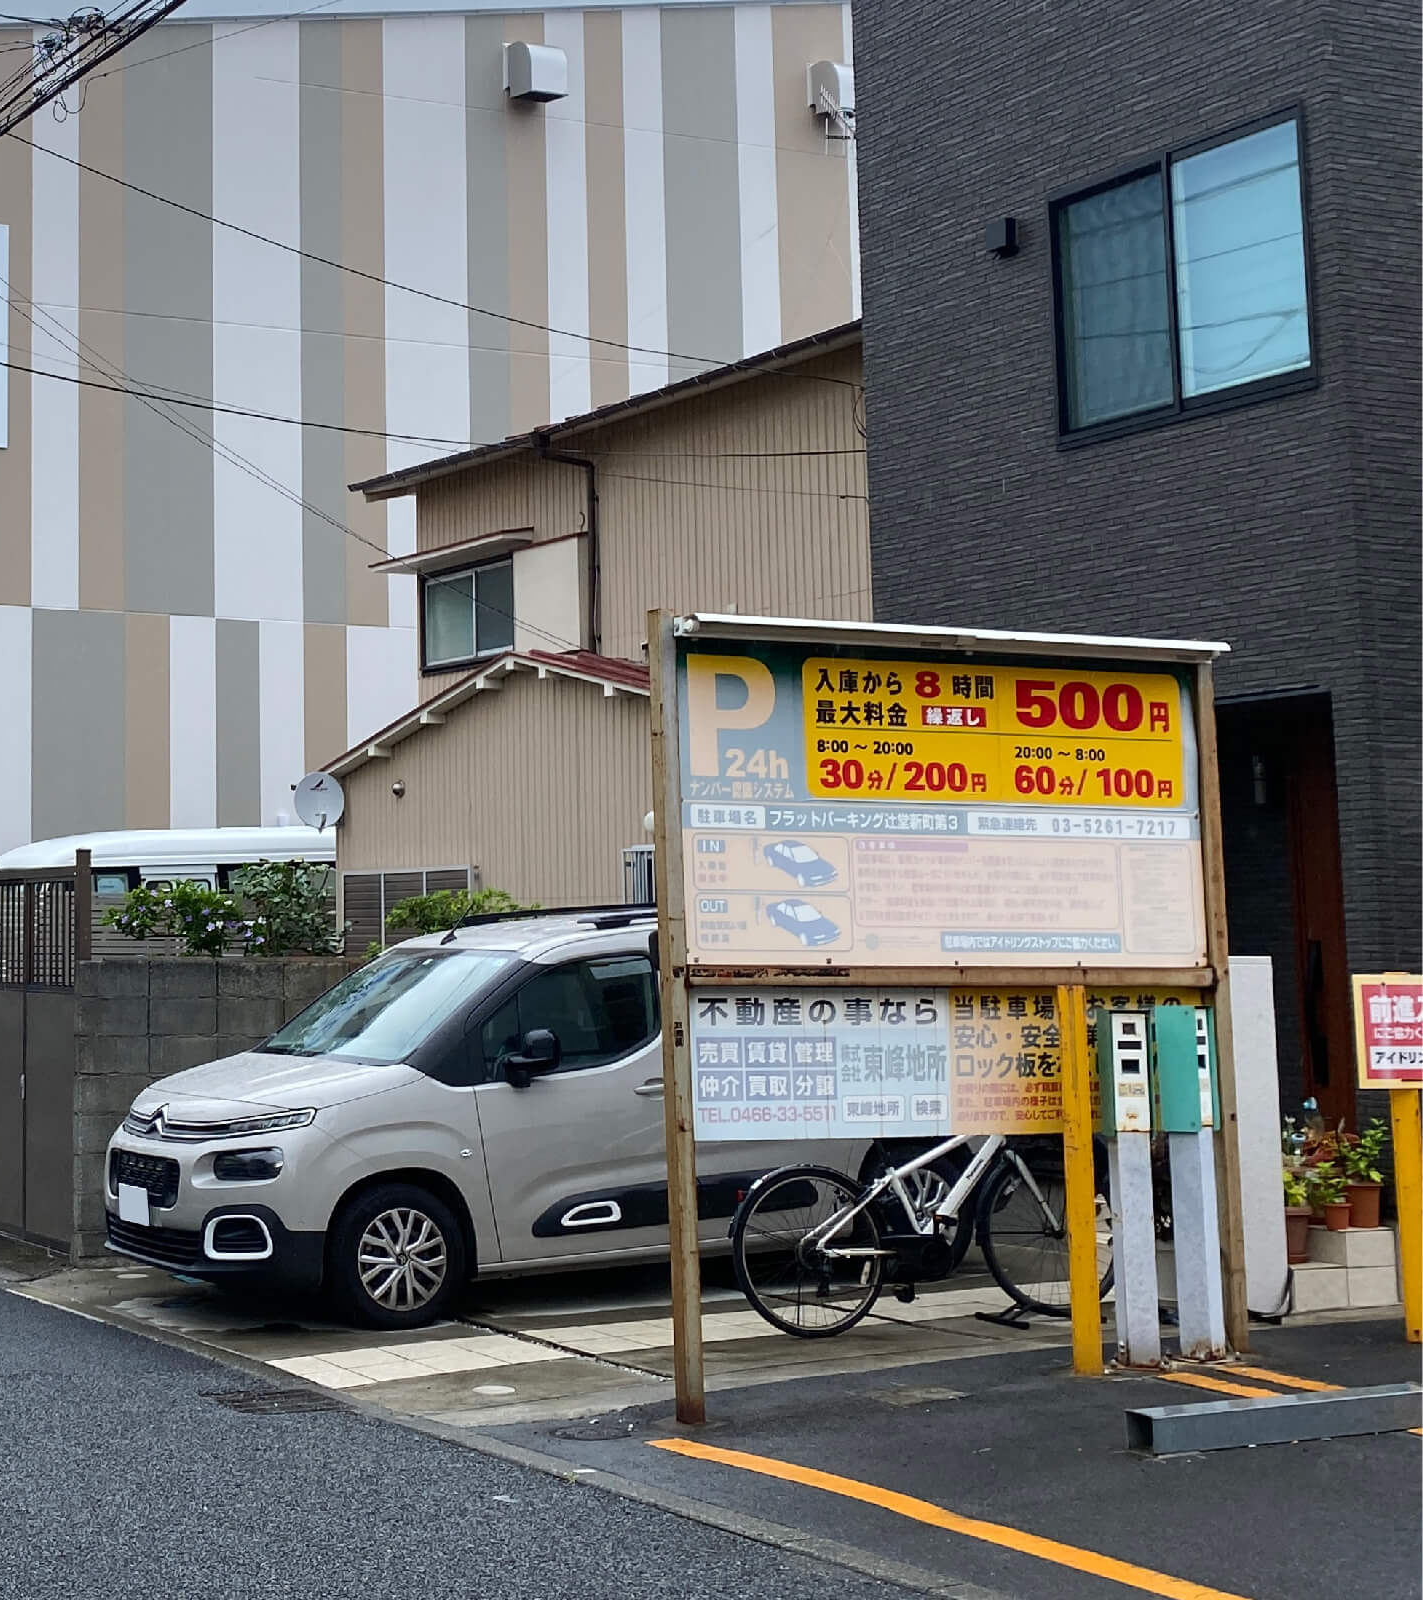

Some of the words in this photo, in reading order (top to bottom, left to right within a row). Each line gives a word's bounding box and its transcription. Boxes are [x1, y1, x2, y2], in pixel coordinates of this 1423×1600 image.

[815, 668, 903, 696] 入庫から
[915, 671, 941, 698] 8
[952, 674, 994, 700] 時間
[686, 653, 776, 776] P
[816, 700, 908, 727] 最大料金
[926, 707, 980, 726] 繰返し
[1015, 680, 1170, 733] 500円
[817, 740, 849, 753] 8:00
[873, 741, 914, 755] 20:00
[1014, 746, 1053, 760] 20:00
[1075, 748, 1105, 761] 8:00
[725, 749, 789, 779] 24h
[1052, 818, 1176, 836] 03-5261-7217
[698, 997, 938, 1026] 不動産の事なら
[1369, 995, 1423, 1023] 前進
[699, 1042, 739, 1064] 売買
[794, 1042, 834, 1064] 管理
[955, 1053, 1061, 1078] ロック板を
[700, 1077, 739, 1098] 仲介
[749, 1076, 787, 1097] 買取
